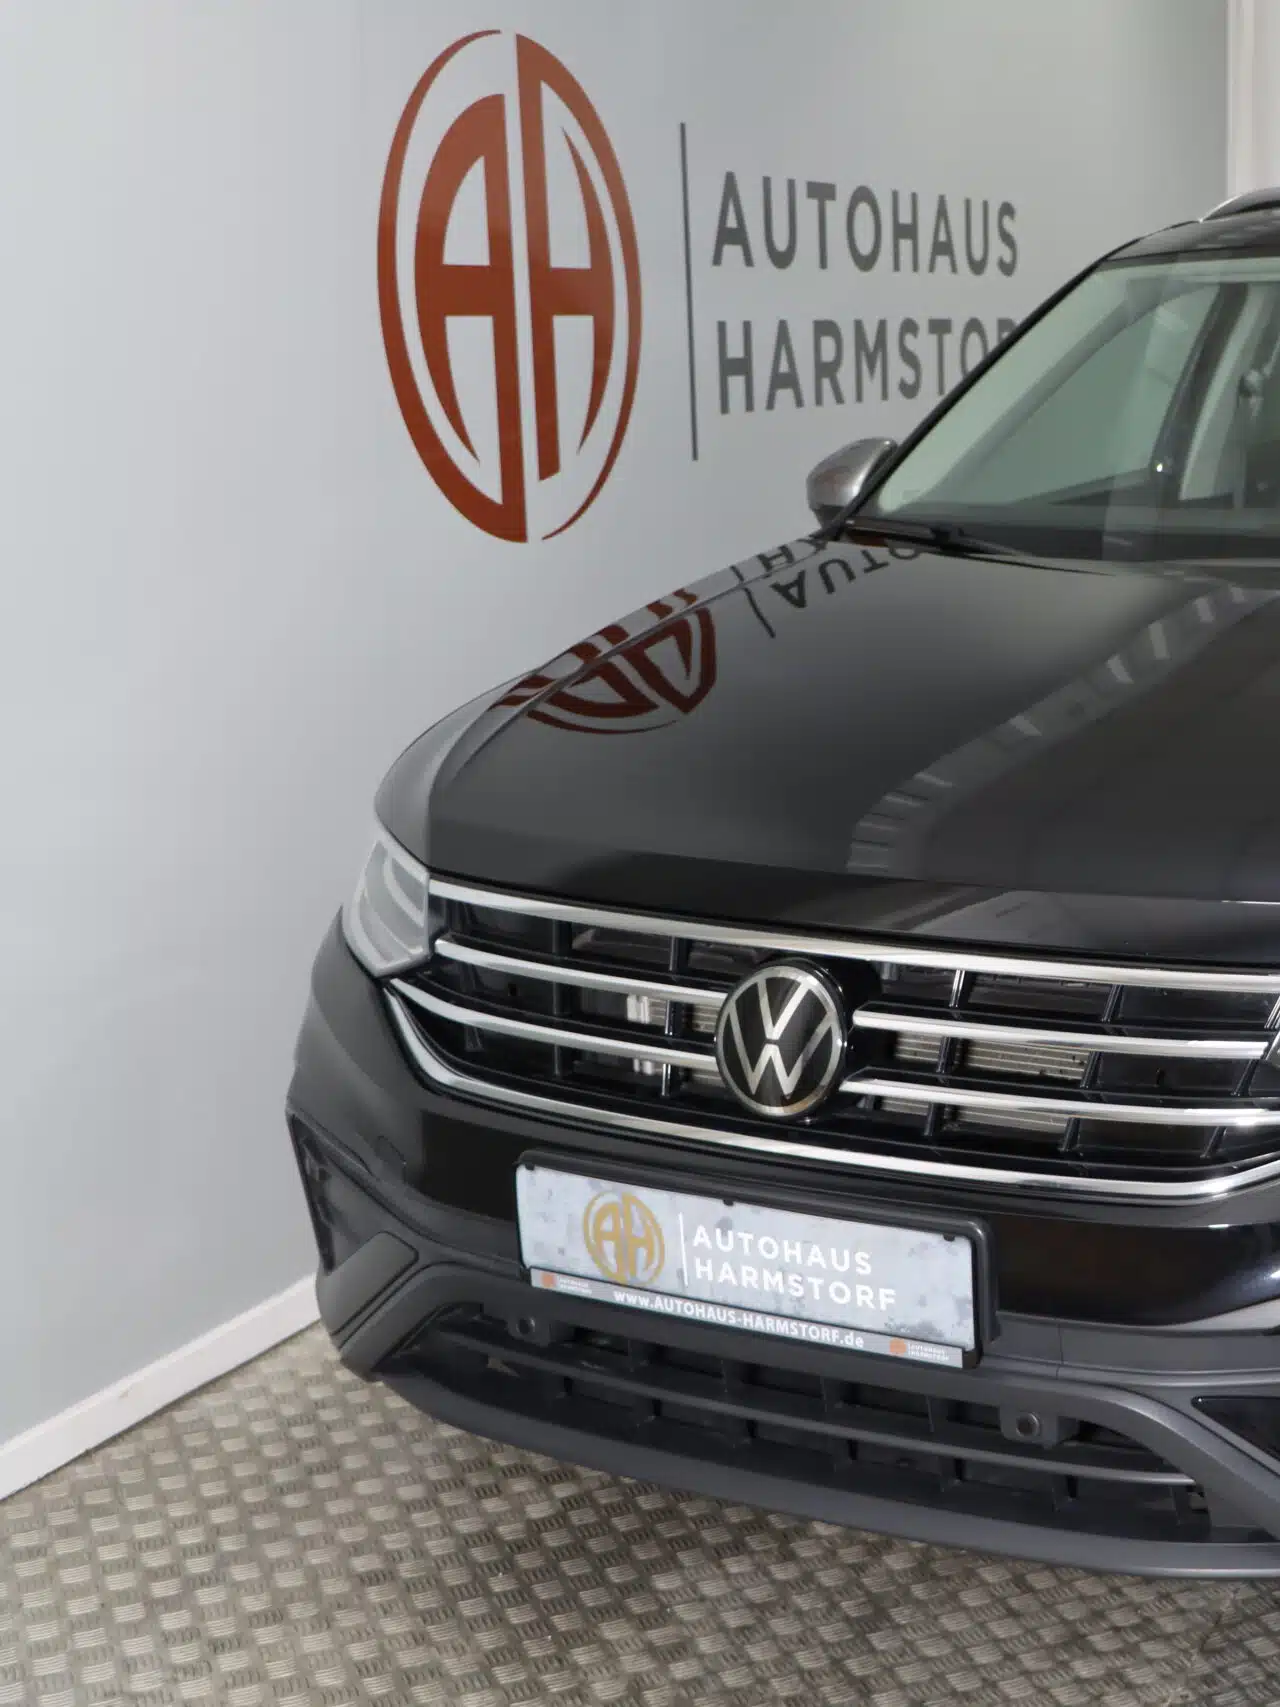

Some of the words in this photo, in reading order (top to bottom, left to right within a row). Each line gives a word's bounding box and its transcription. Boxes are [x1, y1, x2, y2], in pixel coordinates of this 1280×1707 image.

[712, 171, 1019, 278] AUTOHAUS
[693, 1225, 872, 1275] AUTOHAUS
[695, 1257, 897, 1312] HARMSTORF
[613, 1290, 865, 1349] www.AUTOHAUS-HARMSTORF.de
